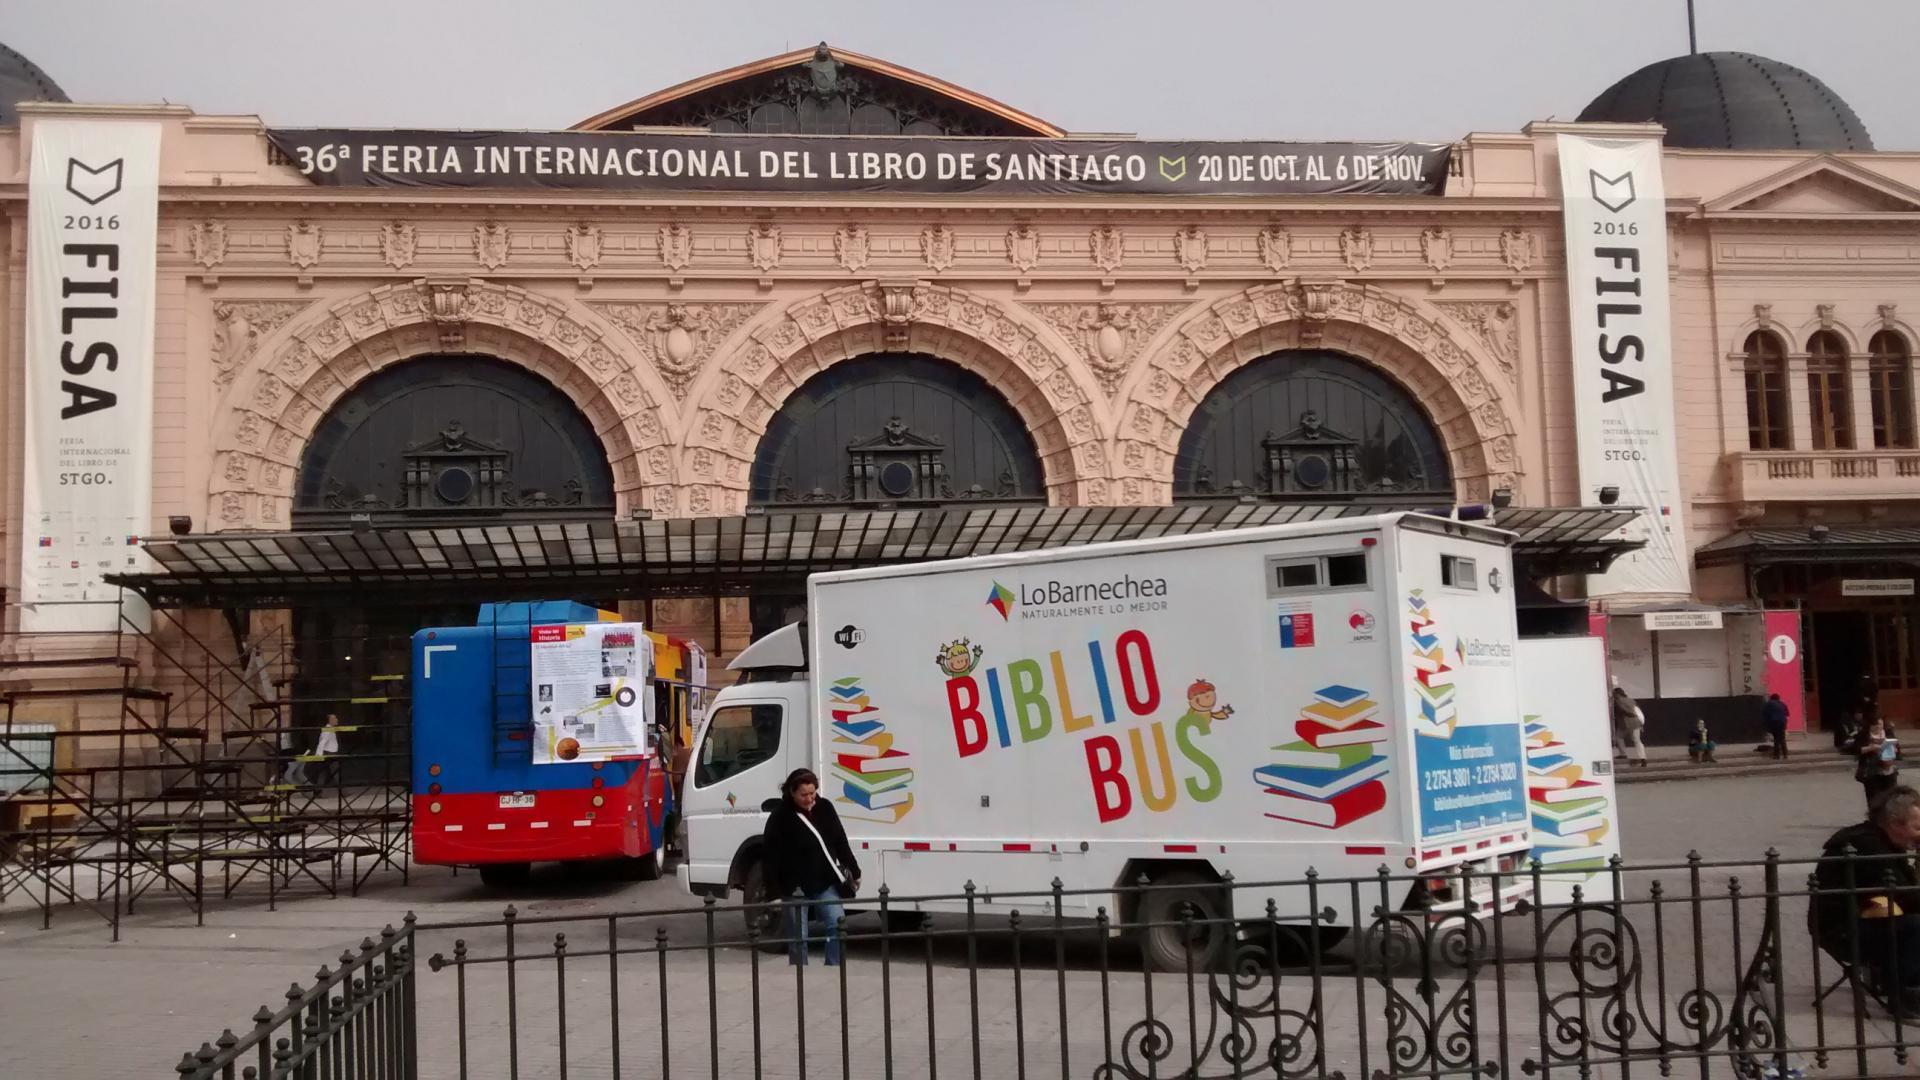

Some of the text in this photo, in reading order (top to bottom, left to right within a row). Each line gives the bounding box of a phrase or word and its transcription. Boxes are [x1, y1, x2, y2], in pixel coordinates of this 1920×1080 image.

[362, 145, 463, 174] FERIA
[474, 146, 750, 177] INTERNACIONAL
[760, 150, 818, 178] DEL
[830, 151, 927, 180] LIBRO
[937, 152, 976, 180] DE
[985, 153, 1146, 182] SANTIAGO
[1198, 155, 1426, 182] 20 DE OCT. AL 6 DE NOV.
[64, 215, 120, 230] 2016
[1593, 222, 1639, 236] 2016
[61, 244, 119, 420] FILSA
[1594, 247, 1645, 403] FILSA
[59, 447, 132, 456] INTERNACIONAL
[1604, 450, 1646, 461] STGO.
[60, 472, 112, 485] STGO.
[1022, 601, 1168, 620] NATURALMENTE LO MEJOR
[945, 629, 1161, 758] BIBLIO
[1084, 714, 1223, 823] BUS
